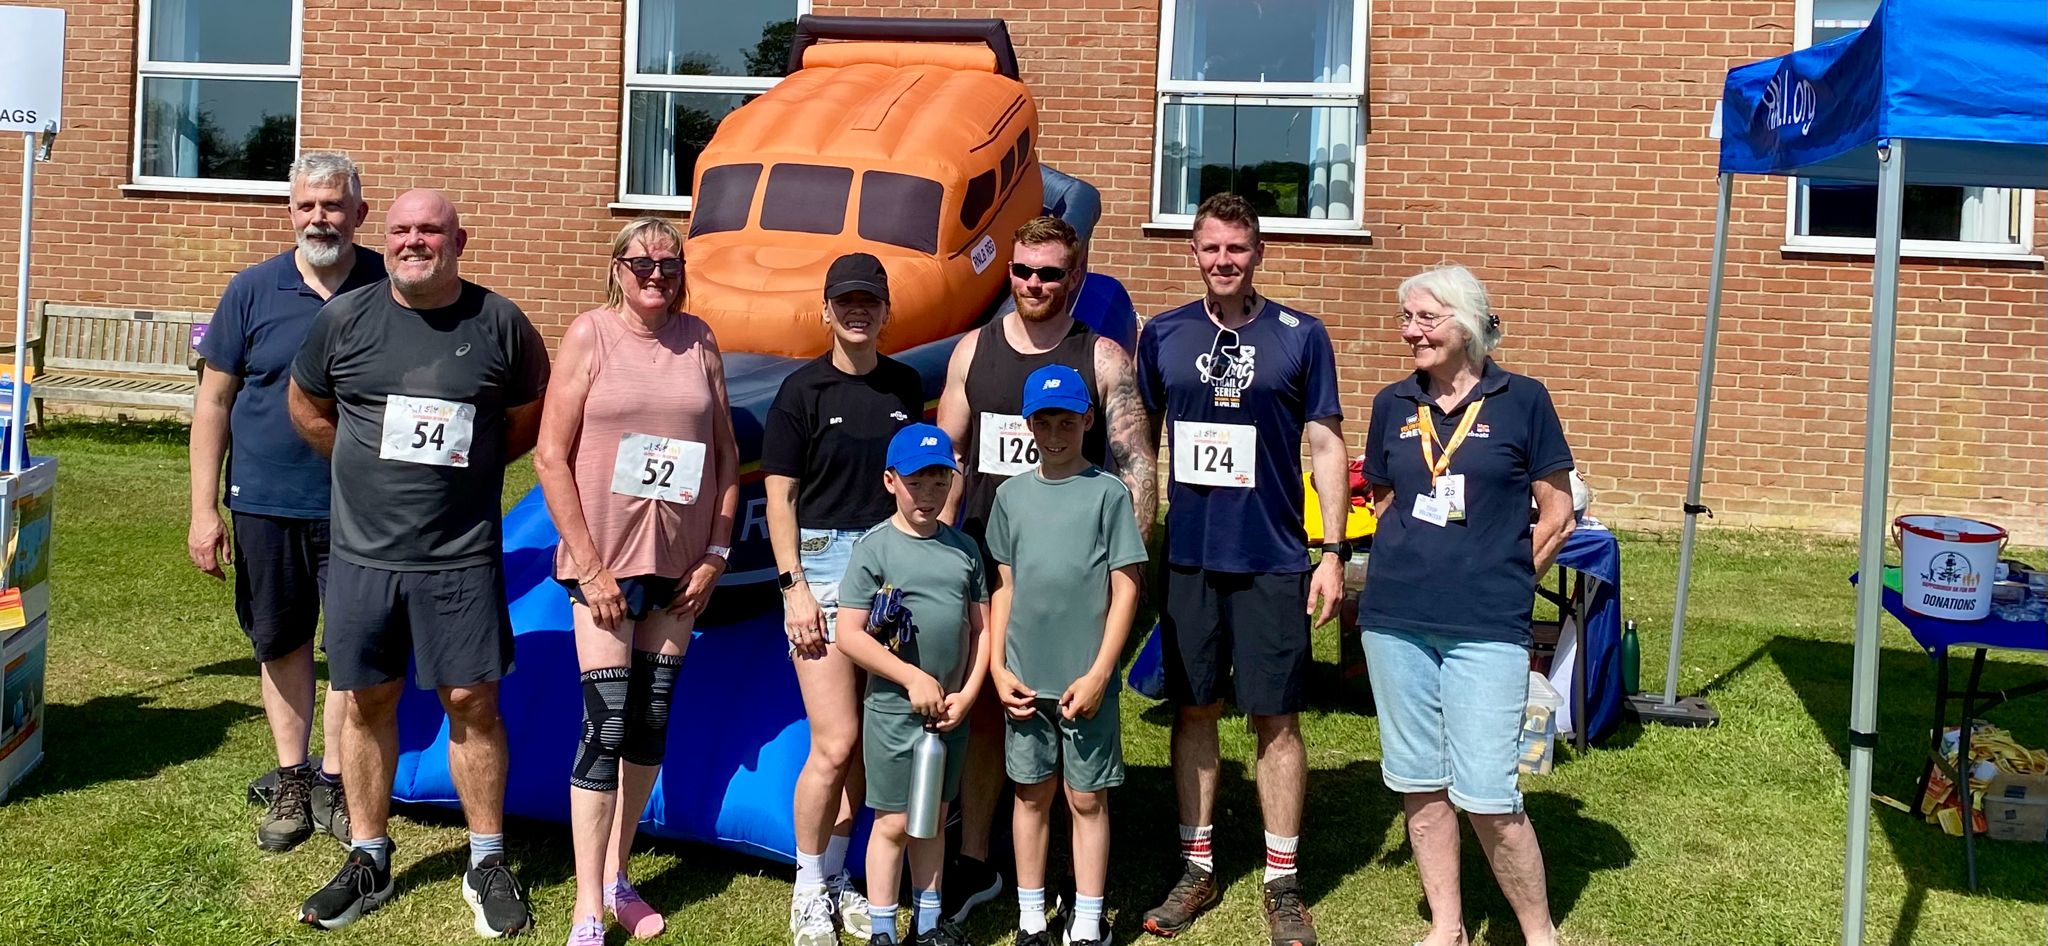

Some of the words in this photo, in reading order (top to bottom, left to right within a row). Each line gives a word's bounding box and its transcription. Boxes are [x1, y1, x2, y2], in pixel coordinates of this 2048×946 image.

[1214, 387, 1241, 398] SERIES
[411, 421, 445, 451] 54
[999, 436, 1040, 465] 126
[641, 458, 675, 488] 52
[1193, 444, 1234, 473] 124
[1923, 594, 1976, 610] DONATIONS
